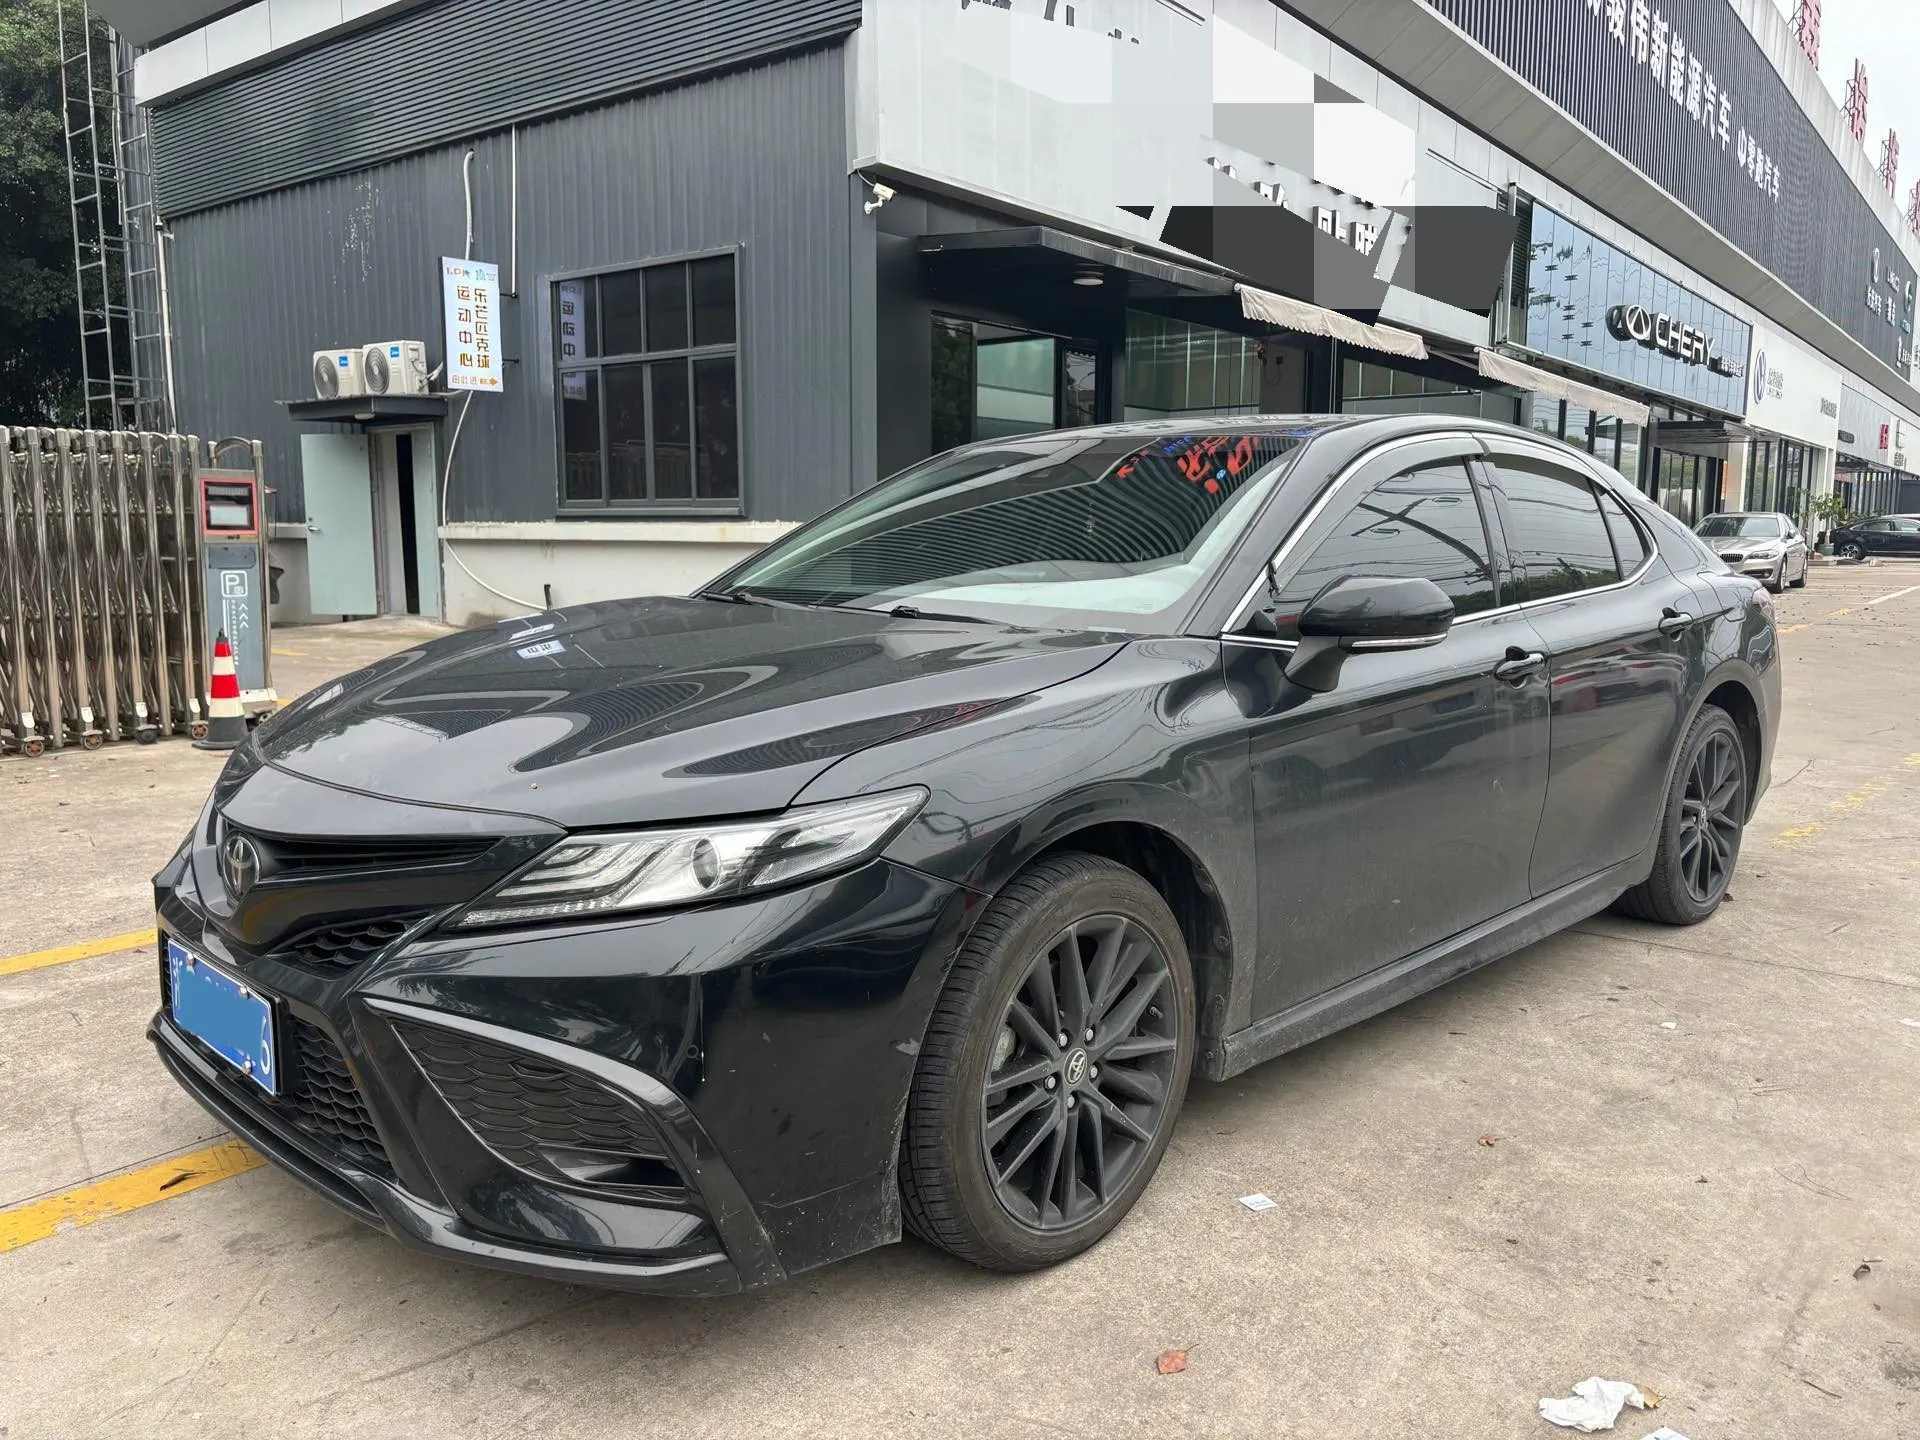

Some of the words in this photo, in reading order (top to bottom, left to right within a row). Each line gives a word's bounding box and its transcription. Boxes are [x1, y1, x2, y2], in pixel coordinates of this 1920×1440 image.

[456, 285, 474, 368] 运动中心
[474, 288, 490, 369] 乐芒匹克球
[1655, 311, 1716, 366] CHERY
